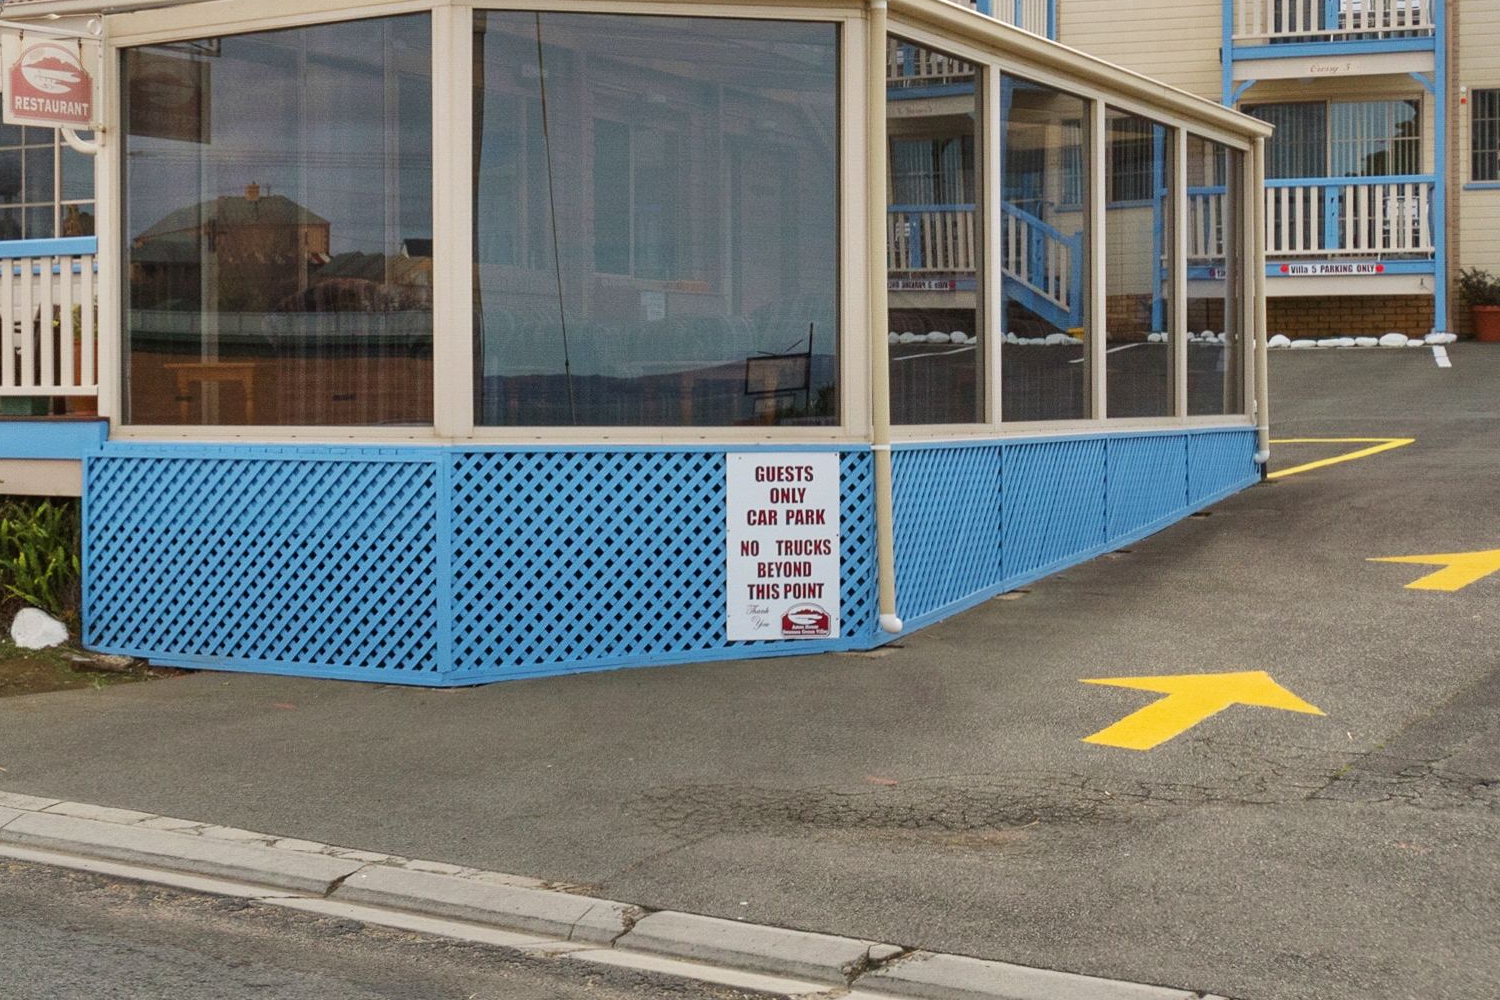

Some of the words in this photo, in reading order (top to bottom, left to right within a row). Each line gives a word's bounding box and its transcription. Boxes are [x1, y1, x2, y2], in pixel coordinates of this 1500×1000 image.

[14, 95, 89, 116] RESTAURANT
[1290, 264, 1308, 274] Villa
[1311, 264, 1317, 274] 5
[1320, 264, 1353, 273] PARKING
[1356, 264, 1374, 273] ONLY
[755, 465, 814, 482] GUESTS
[770, 487, 806, 504] ONLY
[747, 509, 778, 526] CAR
[785, 508, 826, 525] PARK
[740, 540, 760, 557] NO
[775, 538, 832, 556] TRUCKS
[757, 561, 812, 578] BEYOND
[747, 583, 780, 600] THIS
[783, 582, 825, 600] POINT
[746, 604, 770, 615] Thank
[751, 615, 770, 631] You
